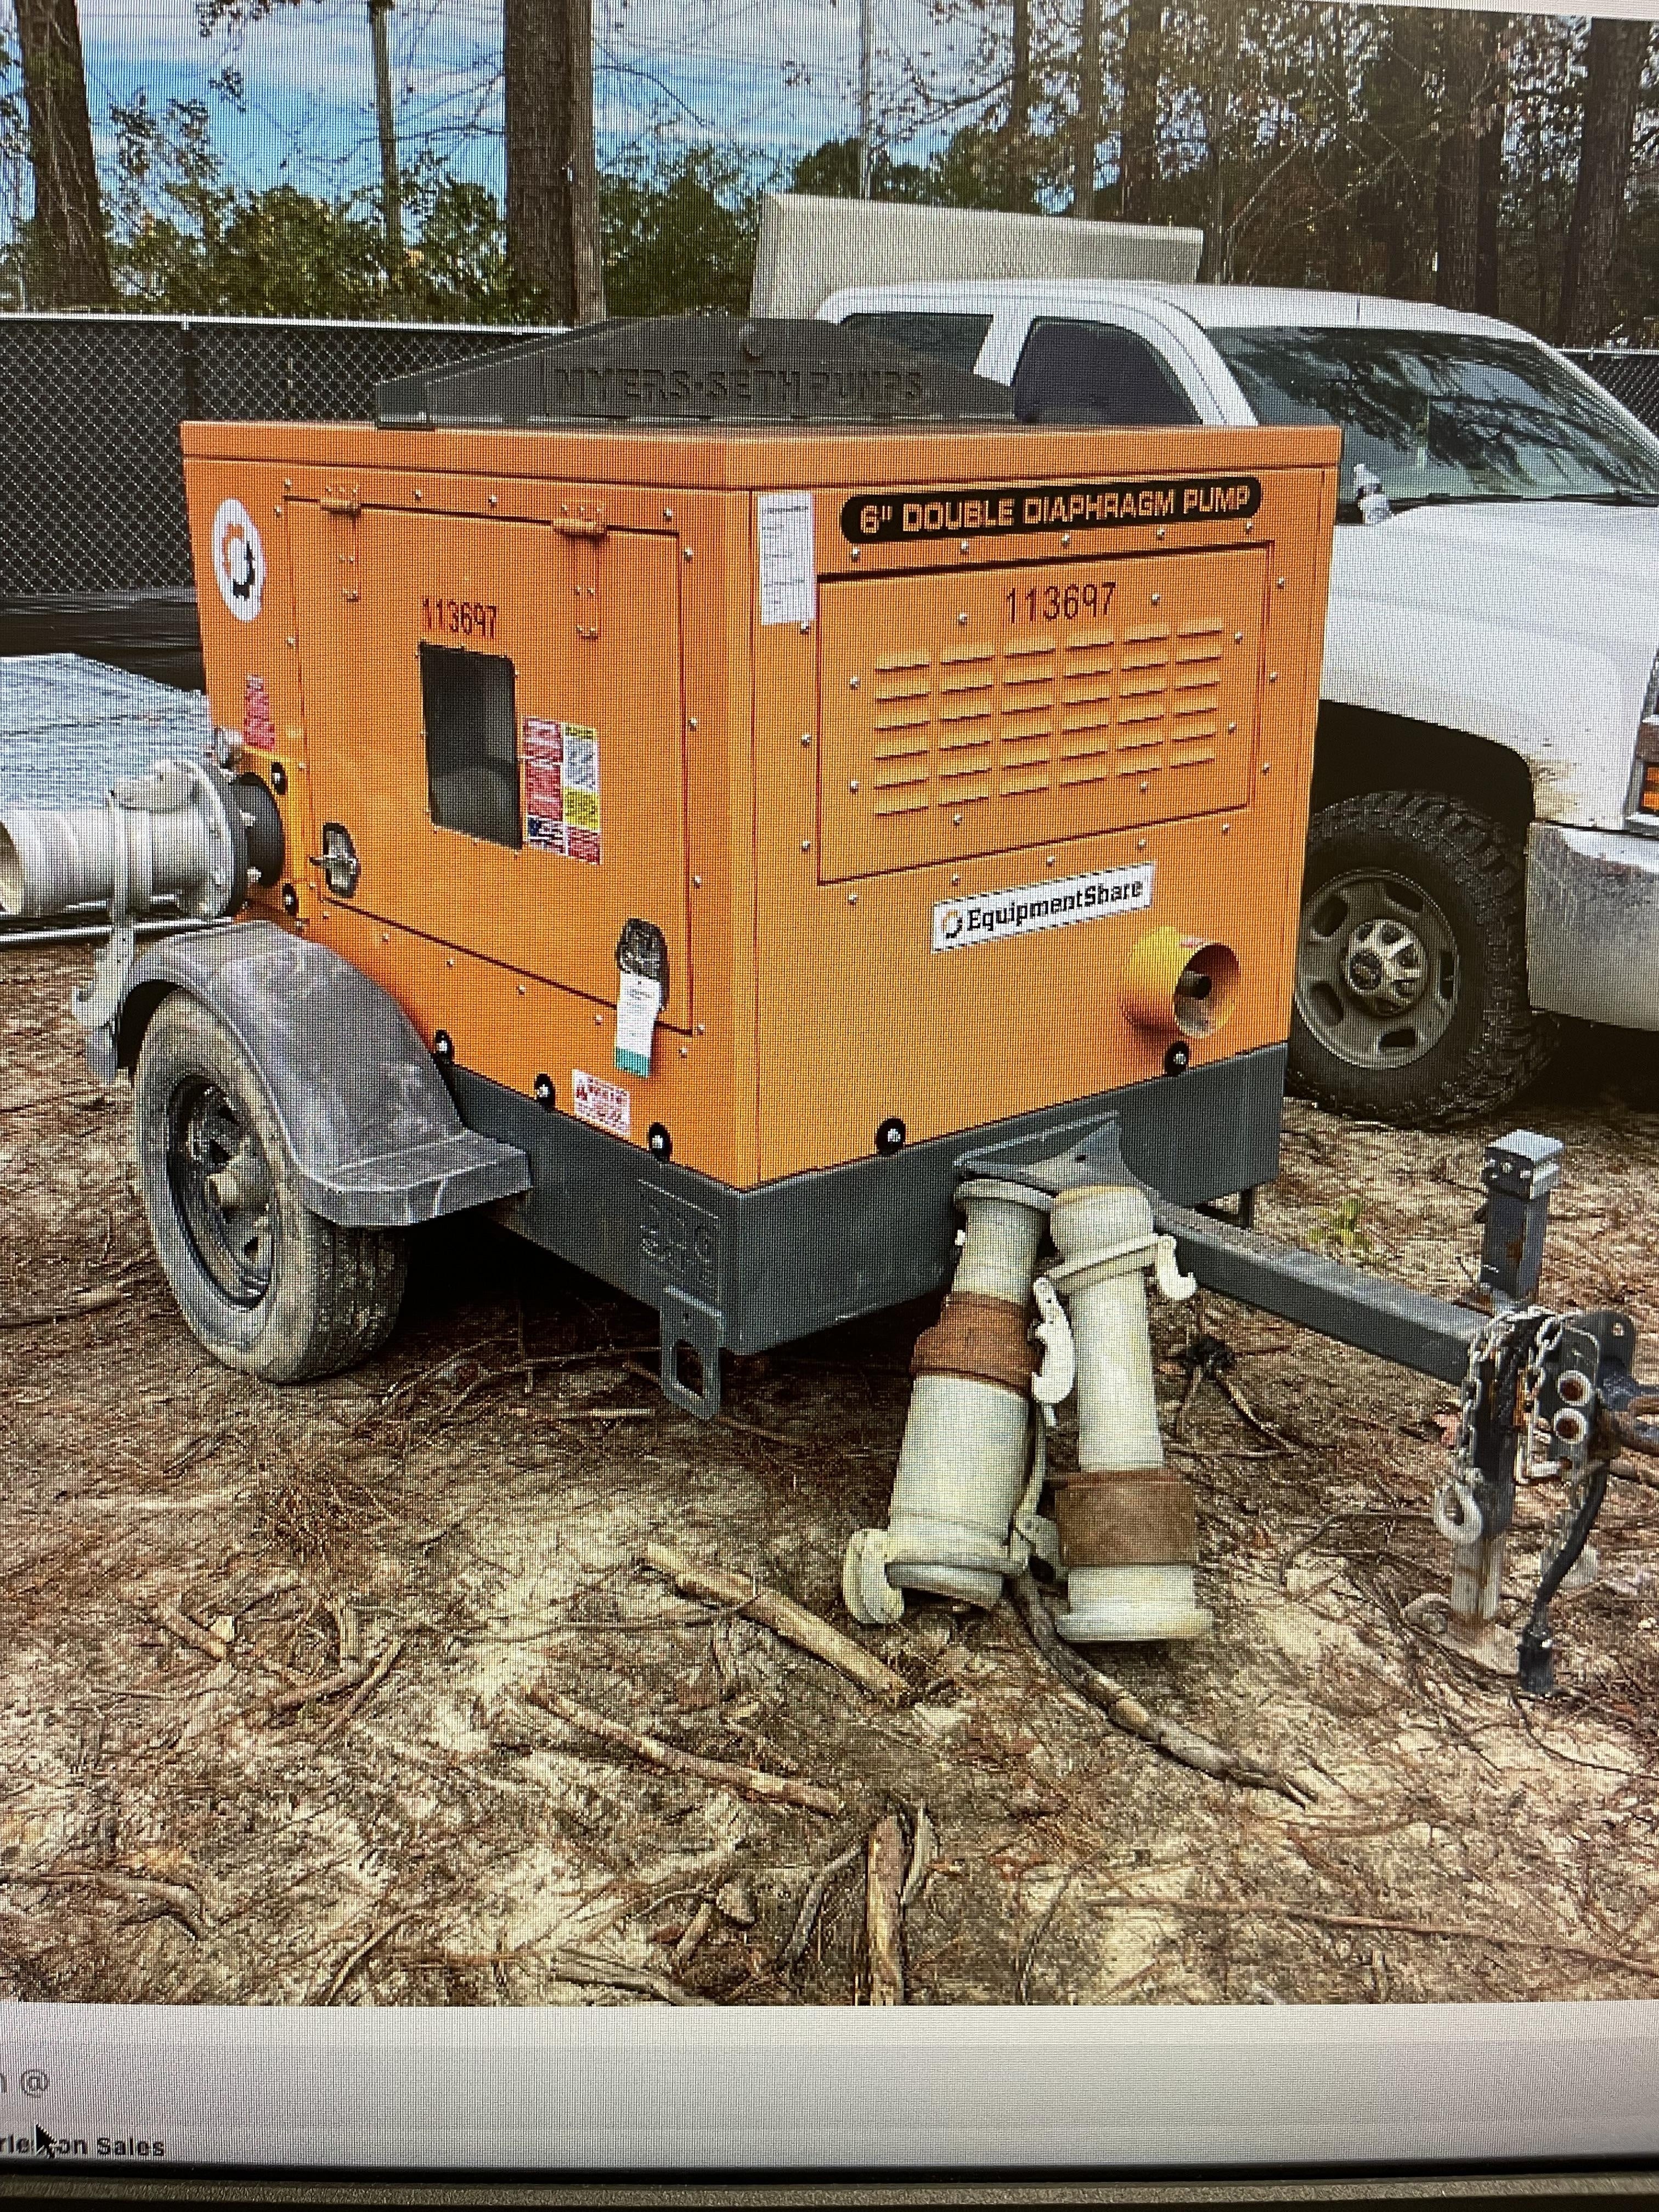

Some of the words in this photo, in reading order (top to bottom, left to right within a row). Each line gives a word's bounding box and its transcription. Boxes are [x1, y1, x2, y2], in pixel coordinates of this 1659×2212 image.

[809, 370, 925, 402] PUMPS
[902, 497, 1015, 532] DOUBLE
[1023, 489, 1176, 524] DIAPHRAGM
[1183, 485, 1250, 514] PUMP
[422, 597, 497, 639] 113697
[1006, 581, 1117, 624] 113697
[967, 880, 1143, 932] EquipmentShare
[98, 2136, 165, 2156] Sales
